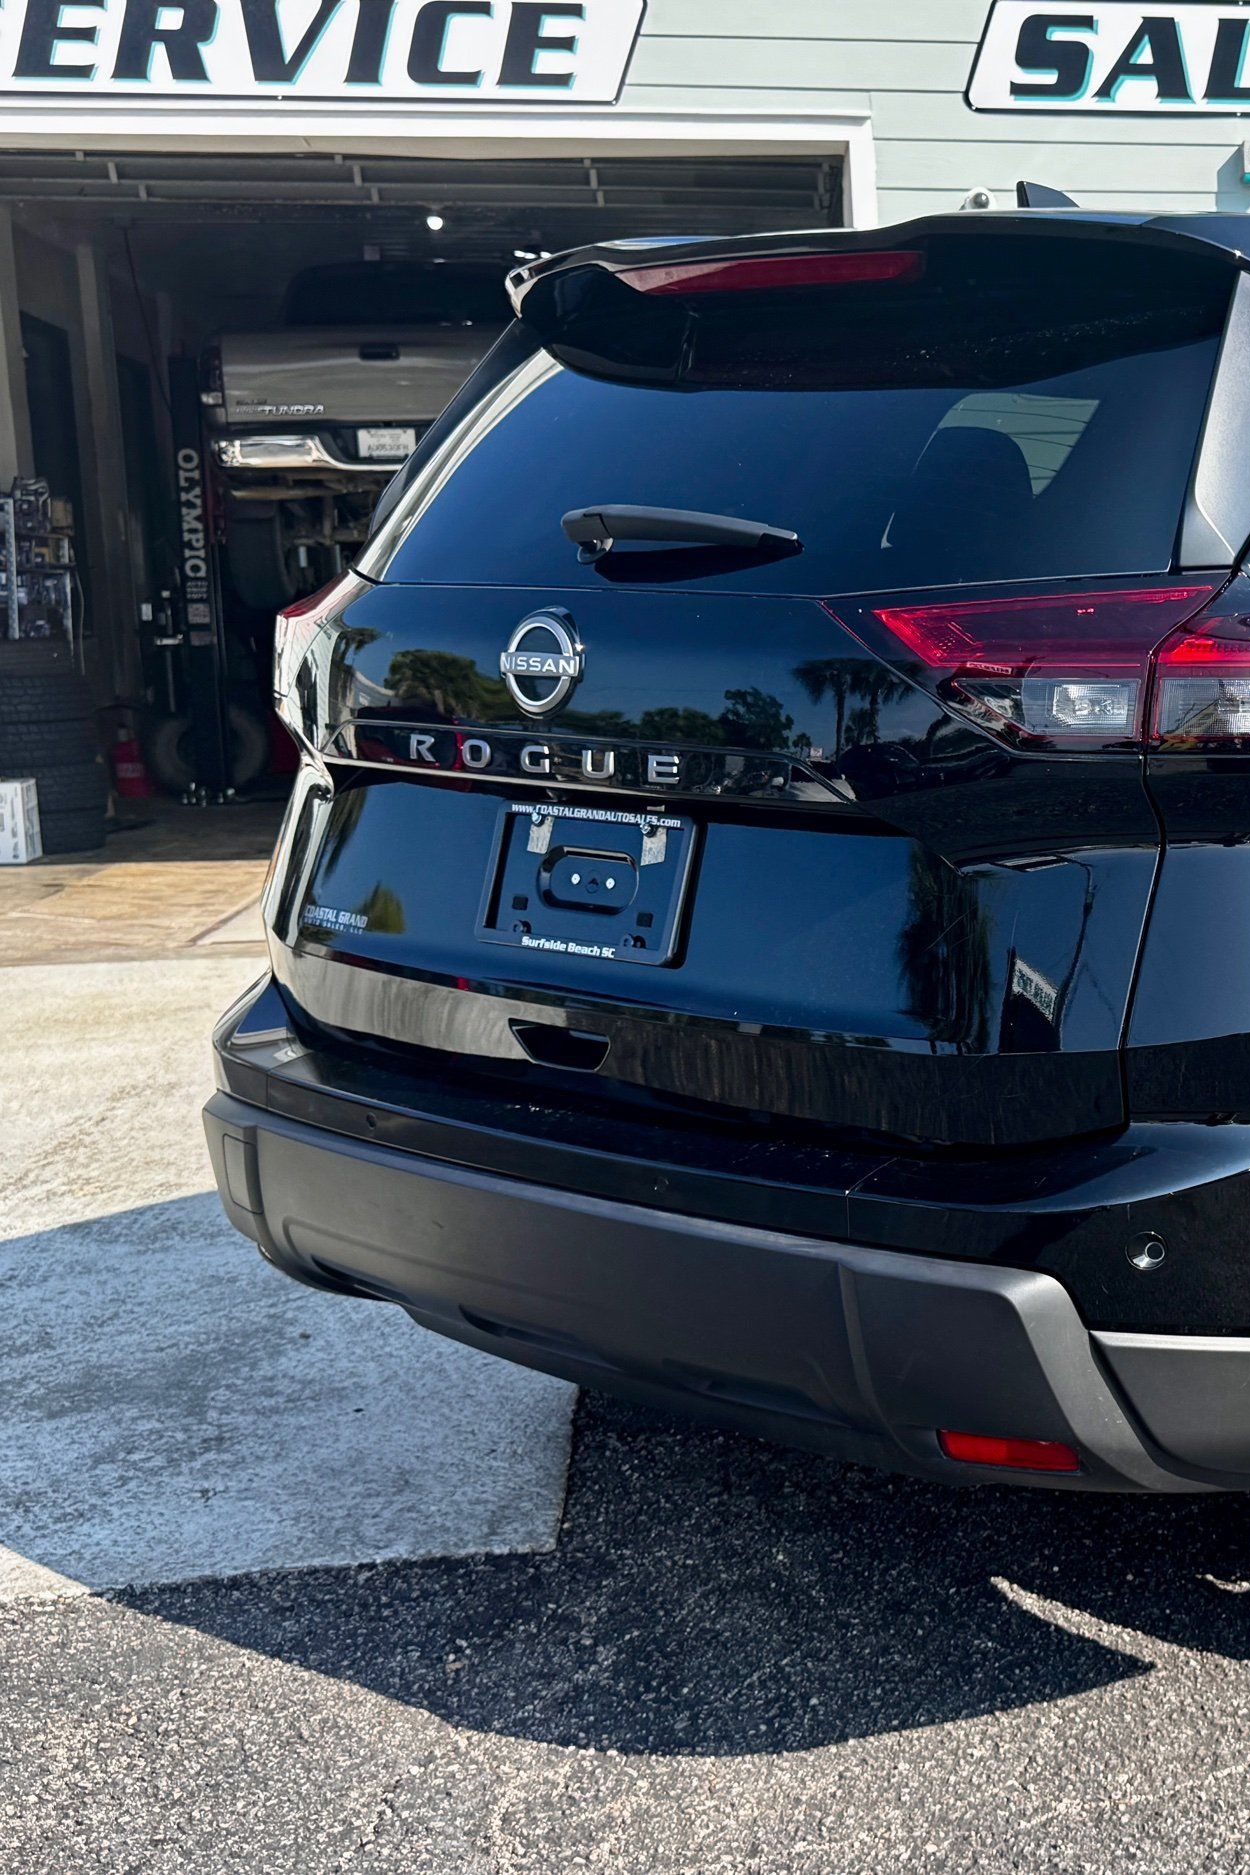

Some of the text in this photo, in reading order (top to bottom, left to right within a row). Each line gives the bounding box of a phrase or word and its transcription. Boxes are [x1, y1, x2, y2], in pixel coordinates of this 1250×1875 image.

[0, 0, 586, 88] ERVICE
[258, 404, 324, 417] TUNDRA
[177, 448, 207, 579] OLYMPIC
[501, 655, 574, 675] NISSAN
[409, 733, 680, 784] ROGUE
[304, 904, 368, 927] COASTAL GRAND
[522, 936, 615, 958] Surfside Beach SC
